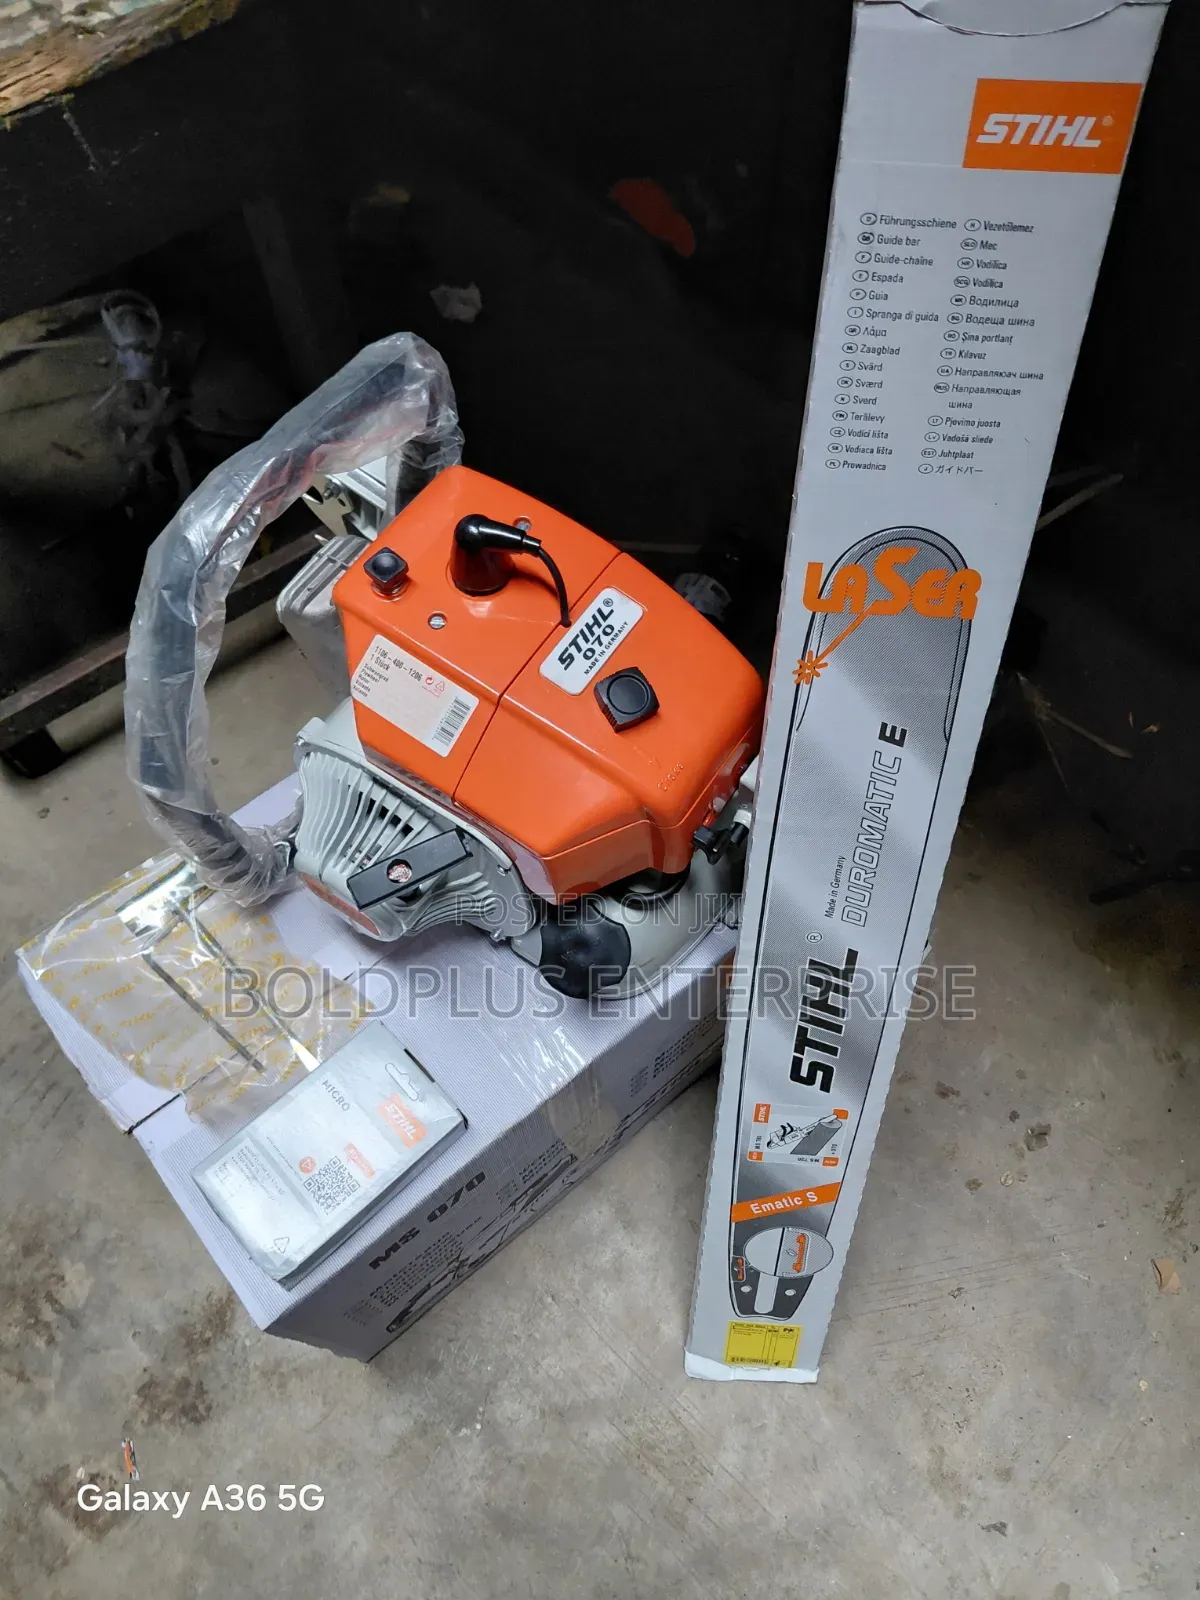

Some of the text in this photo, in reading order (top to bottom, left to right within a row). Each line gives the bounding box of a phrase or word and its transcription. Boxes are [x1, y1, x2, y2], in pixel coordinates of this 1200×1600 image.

[976, 113, 1101, 147] STIHL
[880, 214, 957, 229] Führungsschiene
[877, 234, 903, 246] Guide
[905, 236, 921, 247] bar
[871, 272, 904, 284] Espada
[868, 290, 889, 301] Guia
[968, 295, 1019, 309] Водилица
[865, 308, 903, 322] Spranga
[905, 311, 914, 320] di
[914, 311, 939, 323] guida
[965, 313, 1005, 325] Водеща
[1008, 318, 1035, 327] шина
[860, 344, 901, 356] Zaagblad
[857, 361, 883, 372] Svärd
[1019, 372, 1044, 380] шина
[855, 378, 883, 389] Sværd
[951, 383, 1021, 396] Направляющая
[852, 395, 878, 405] Sverd
[948, 401, 973, 409] шина
[850, 411, 886, 424] Terälevy
[944, 416, 976, 428] Pjovimo
[976, 418, 1001, 429] juosta
[970, 435, 994, 444] sliede
[845, 444, 875, 454] Vodiaca
[938, 449, 975, 460] Juhtplaat
[842, 460, 887, 471] Prowadnica
[584, 621, 629, 676] MADE IN GERMANY
[841, 721, 908, 928] DUROMATIC E
[824, 855, 848, 919] Made in Germany
[321, 1079, 351, 1113] MICRO
[749, 1191, 819, 1215] Ematic S
[368, 1226, 420, 1270] MS
[427, 1171, 486, 1223] 070
